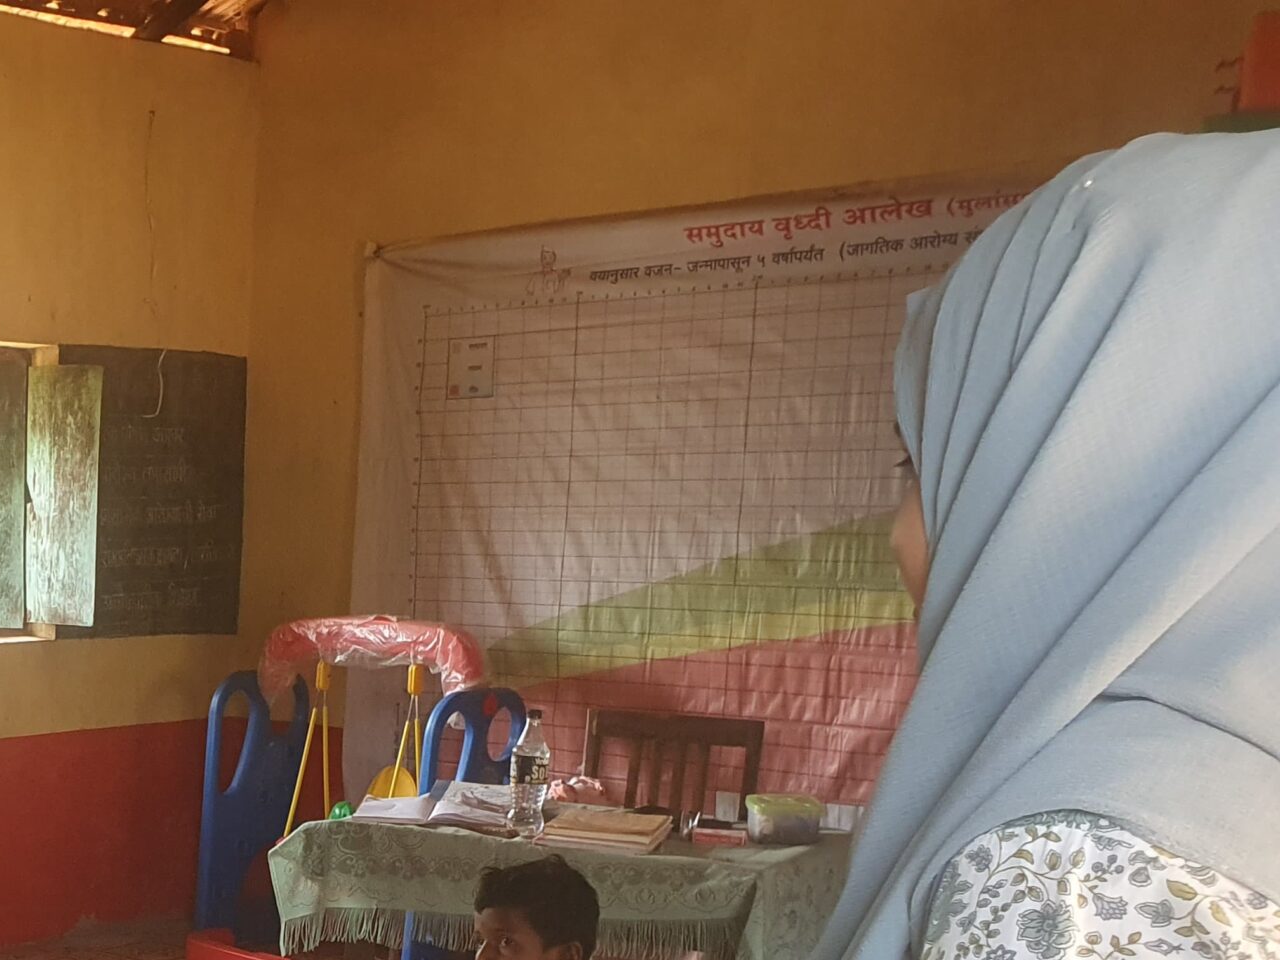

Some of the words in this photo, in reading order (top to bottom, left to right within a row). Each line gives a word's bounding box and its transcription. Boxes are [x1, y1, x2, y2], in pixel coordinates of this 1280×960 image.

[684, 220, 765, 248] समुदाय
[772, 206, 832, 240] वृध्दी
[843, 195, 934, 226] आलेख
[590, 266, 641, 284] वयानुसार
[687, 255, 752, 275] जन्मापासून
[839, 236, 904, 262] (जागतिक
[910, 230, 958, 250] आरोग्य
